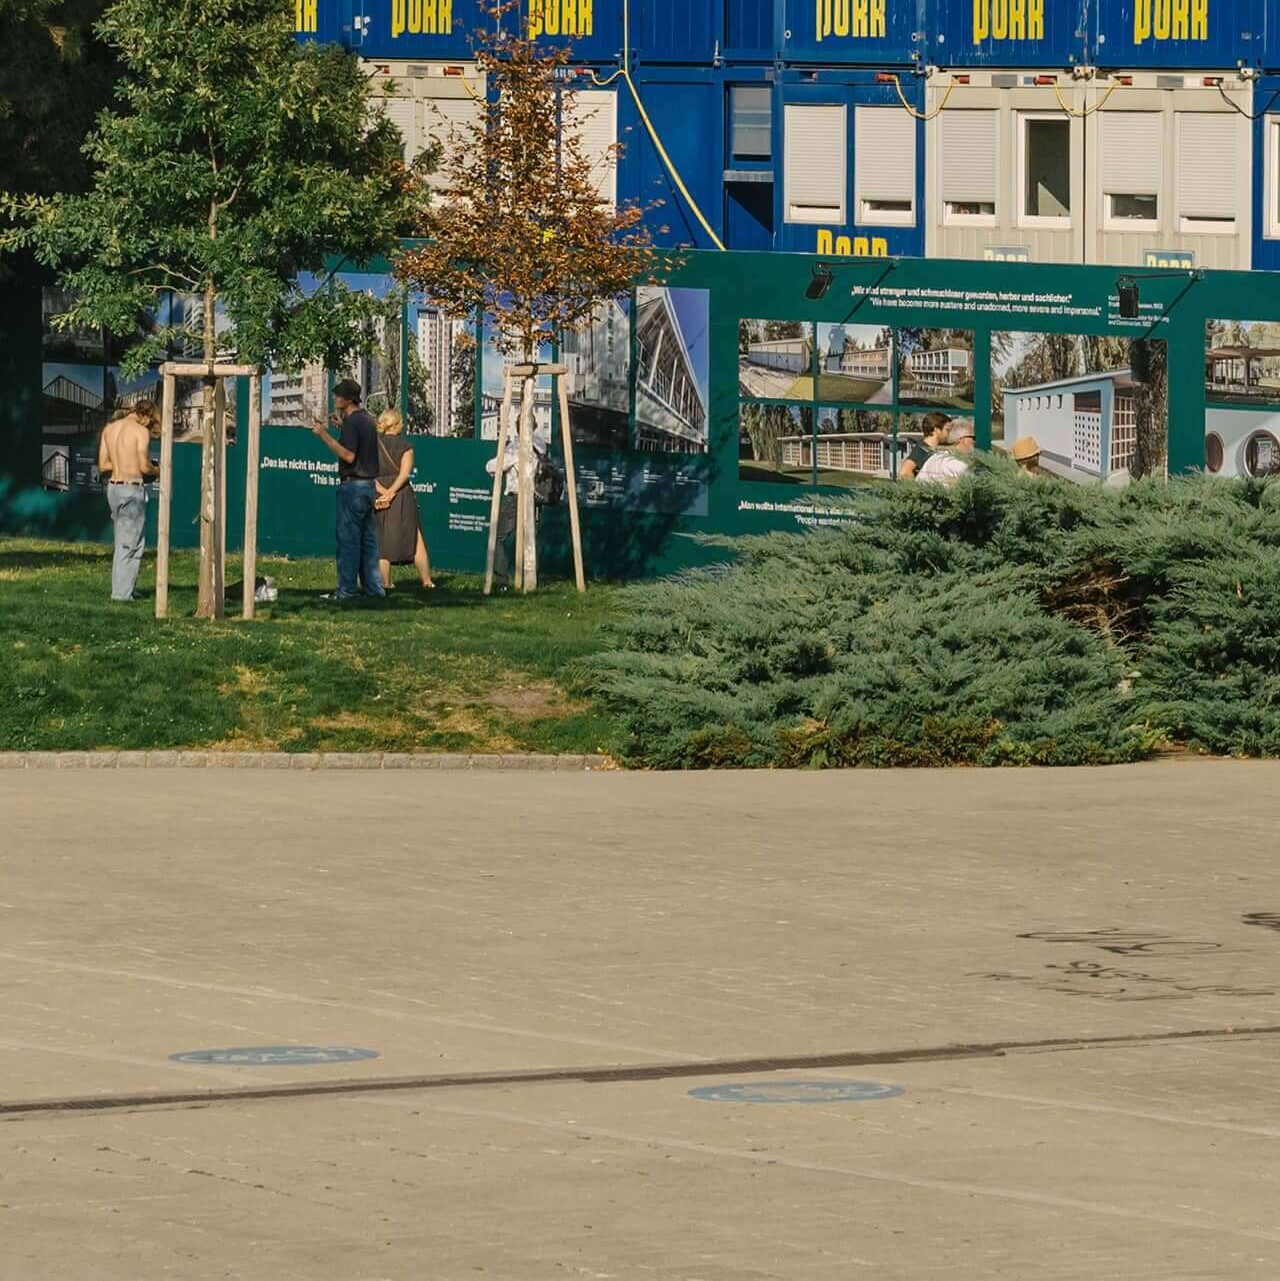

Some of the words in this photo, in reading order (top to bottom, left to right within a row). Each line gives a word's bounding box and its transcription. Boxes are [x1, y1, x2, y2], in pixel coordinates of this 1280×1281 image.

[964, 302, 976, 311] and
[1050, 305, 1063, 315] and
[278, 458, 288, 469] ist
[289, 458, 307, 470] nicht
[308, 460, 315, 471] in
[316, 461, 339, 472] Ameri
